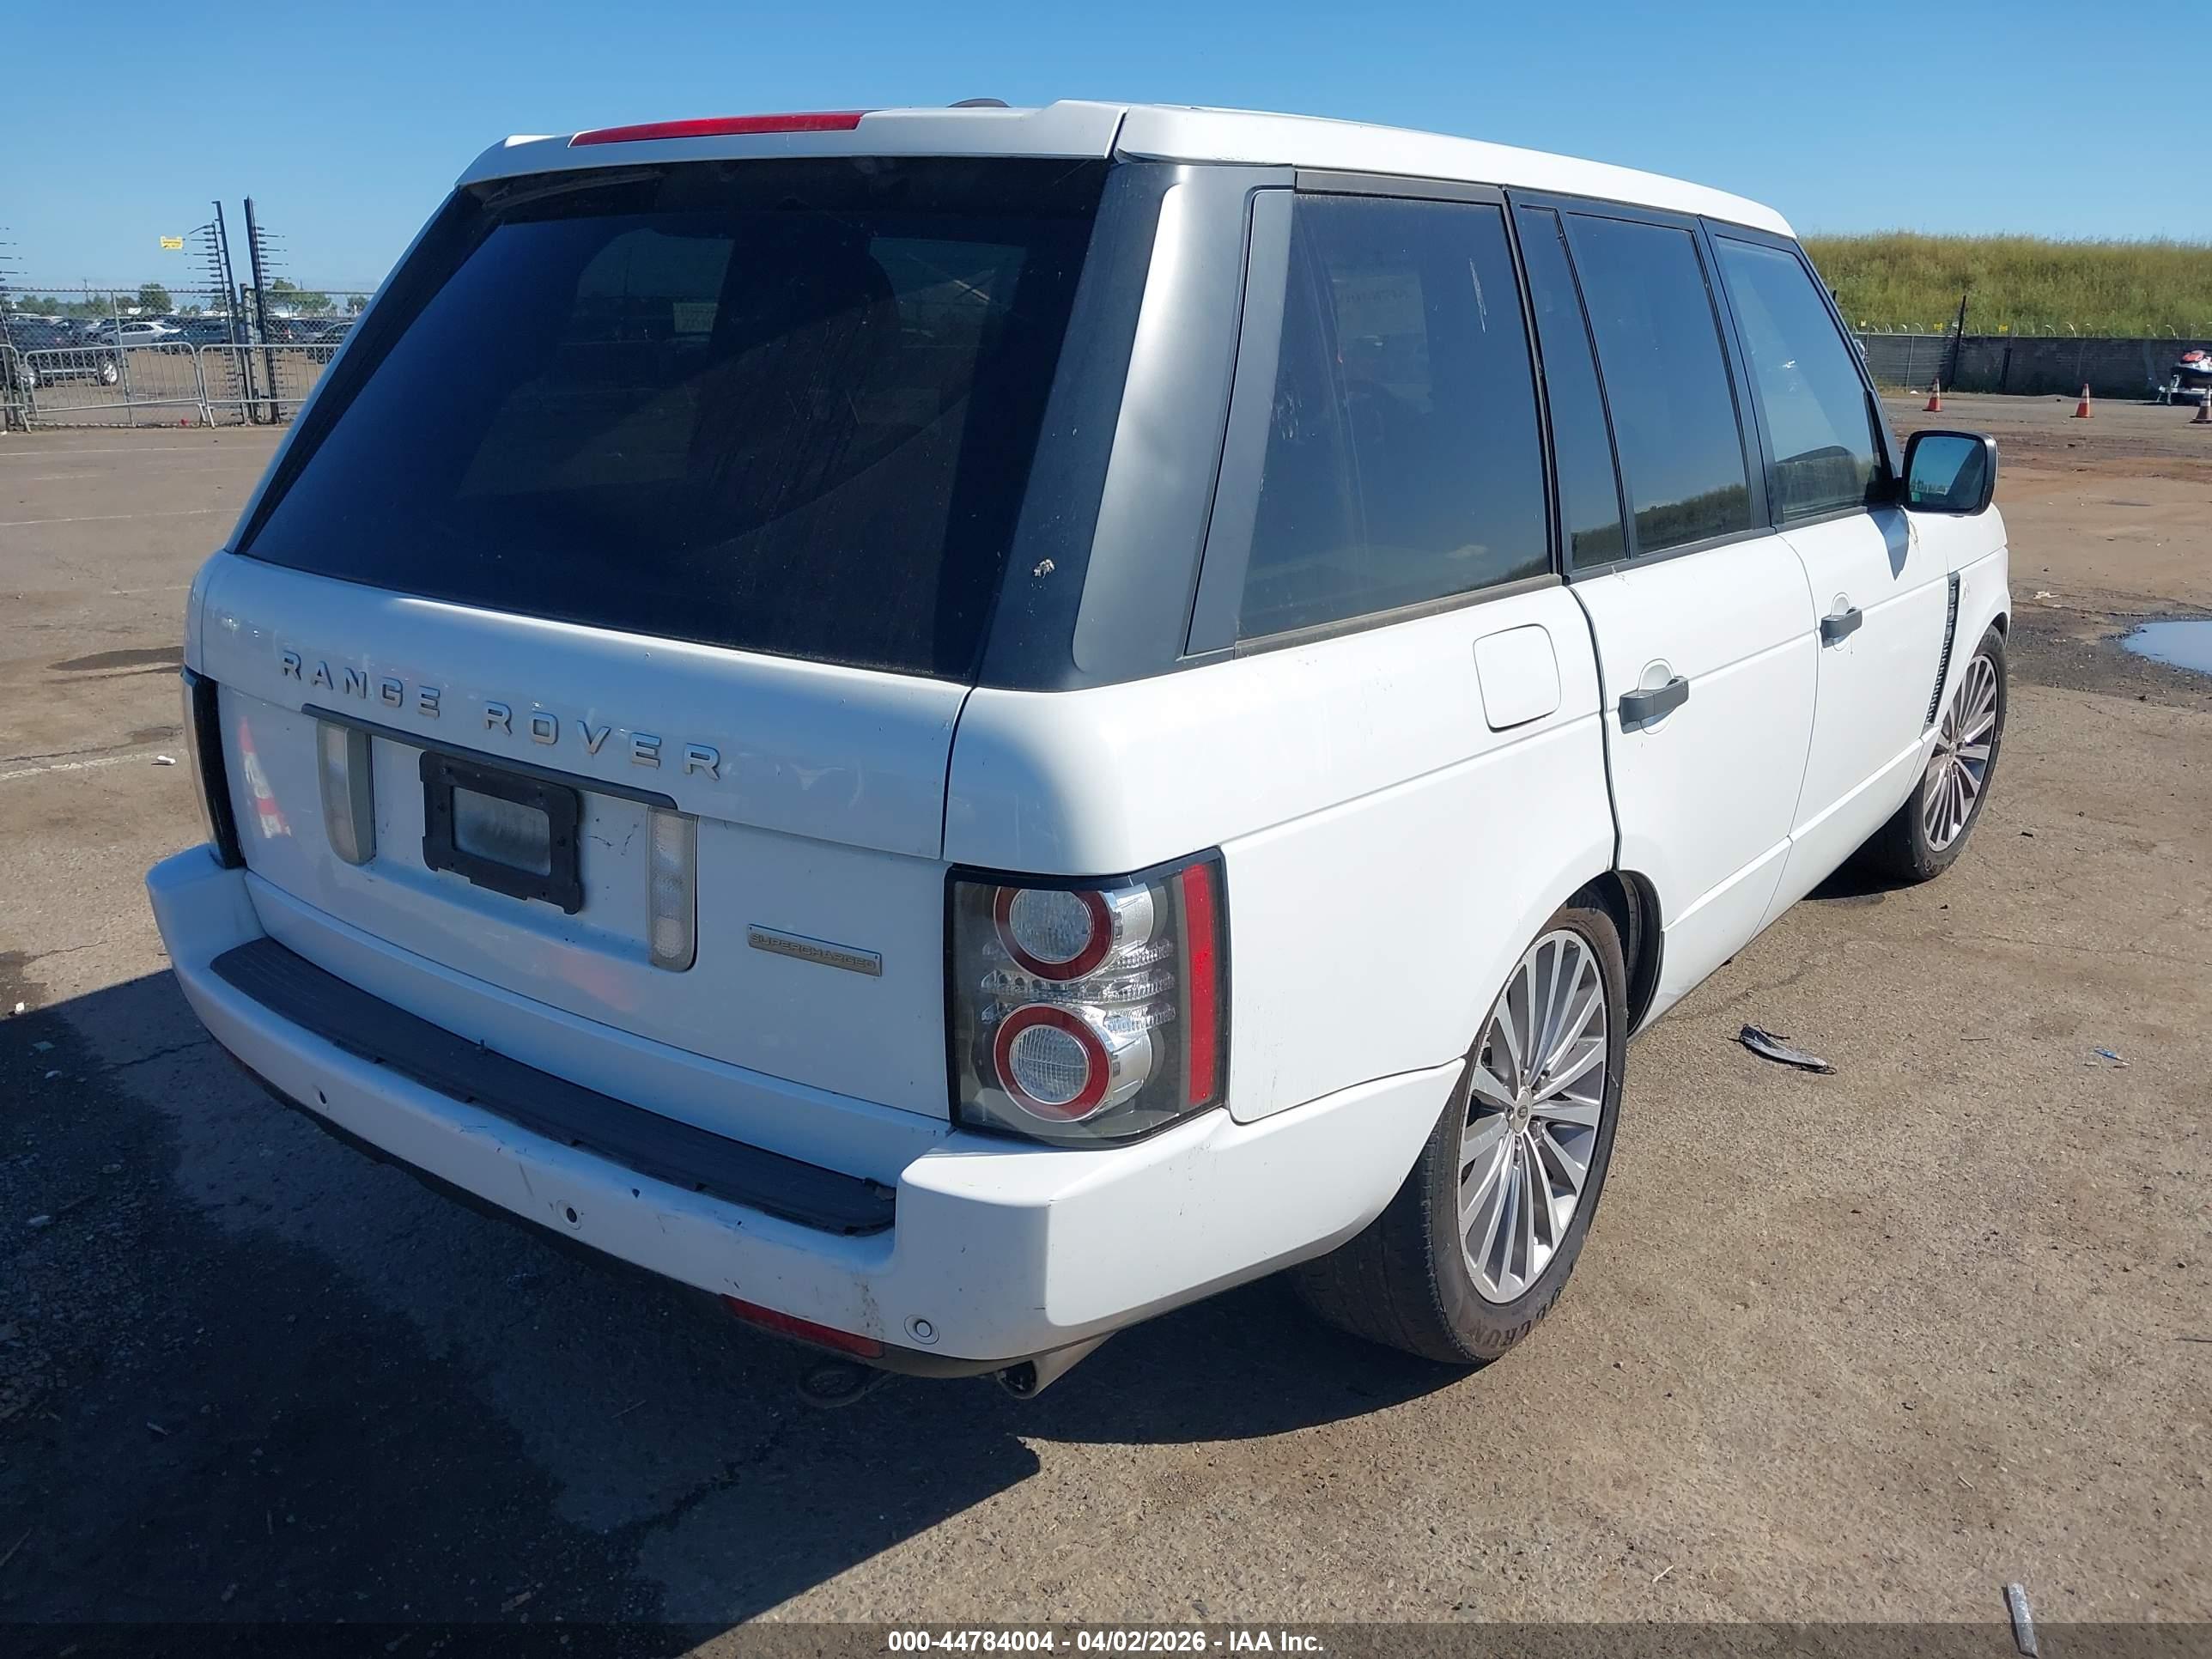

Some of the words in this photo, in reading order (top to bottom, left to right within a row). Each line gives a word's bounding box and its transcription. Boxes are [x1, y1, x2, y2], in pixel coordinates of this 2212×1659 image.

[282, 650, 441, 718] RANGE
[484, 701, 720, 781] ROVER
[750, 933, 877, 969] SUPERCHARGED
